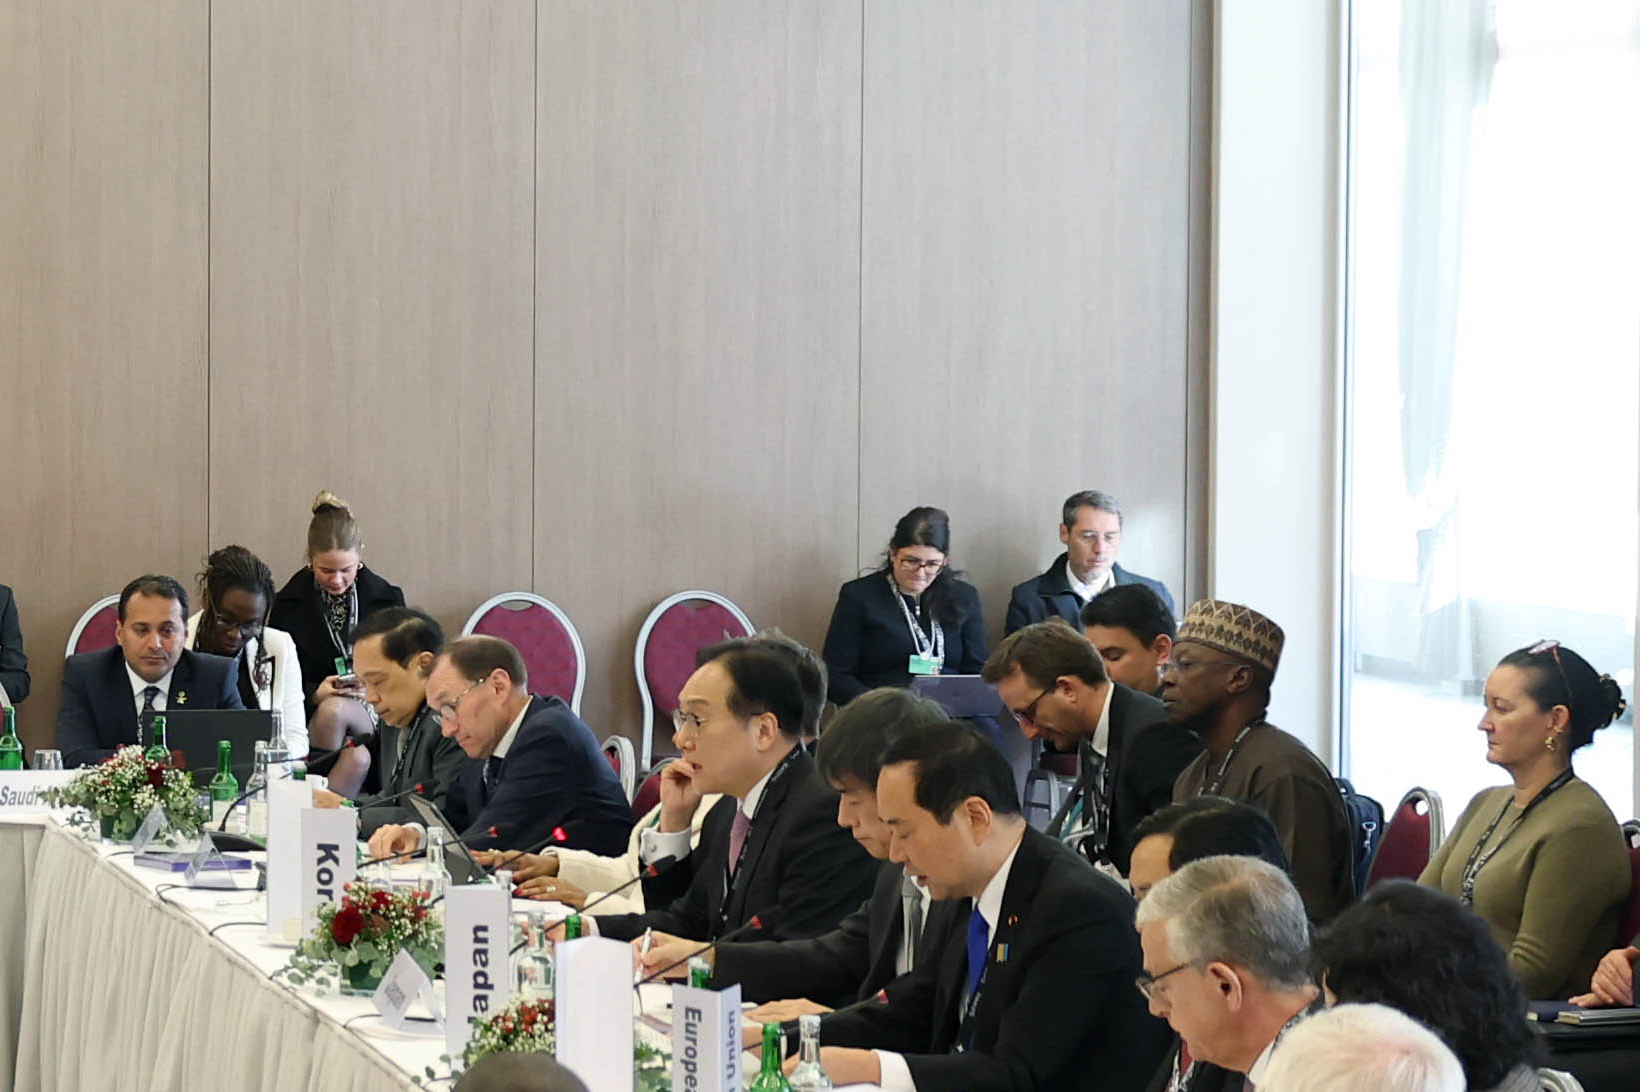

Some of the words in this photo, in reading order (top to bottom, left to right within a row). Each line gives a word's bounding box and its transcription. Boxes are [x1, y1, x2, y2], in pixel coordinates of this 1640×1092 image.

[0, 785, 40, 806] Saudi
[316, 842, 340, 903] Kor
[726, 1010, 736, 1081] Union
